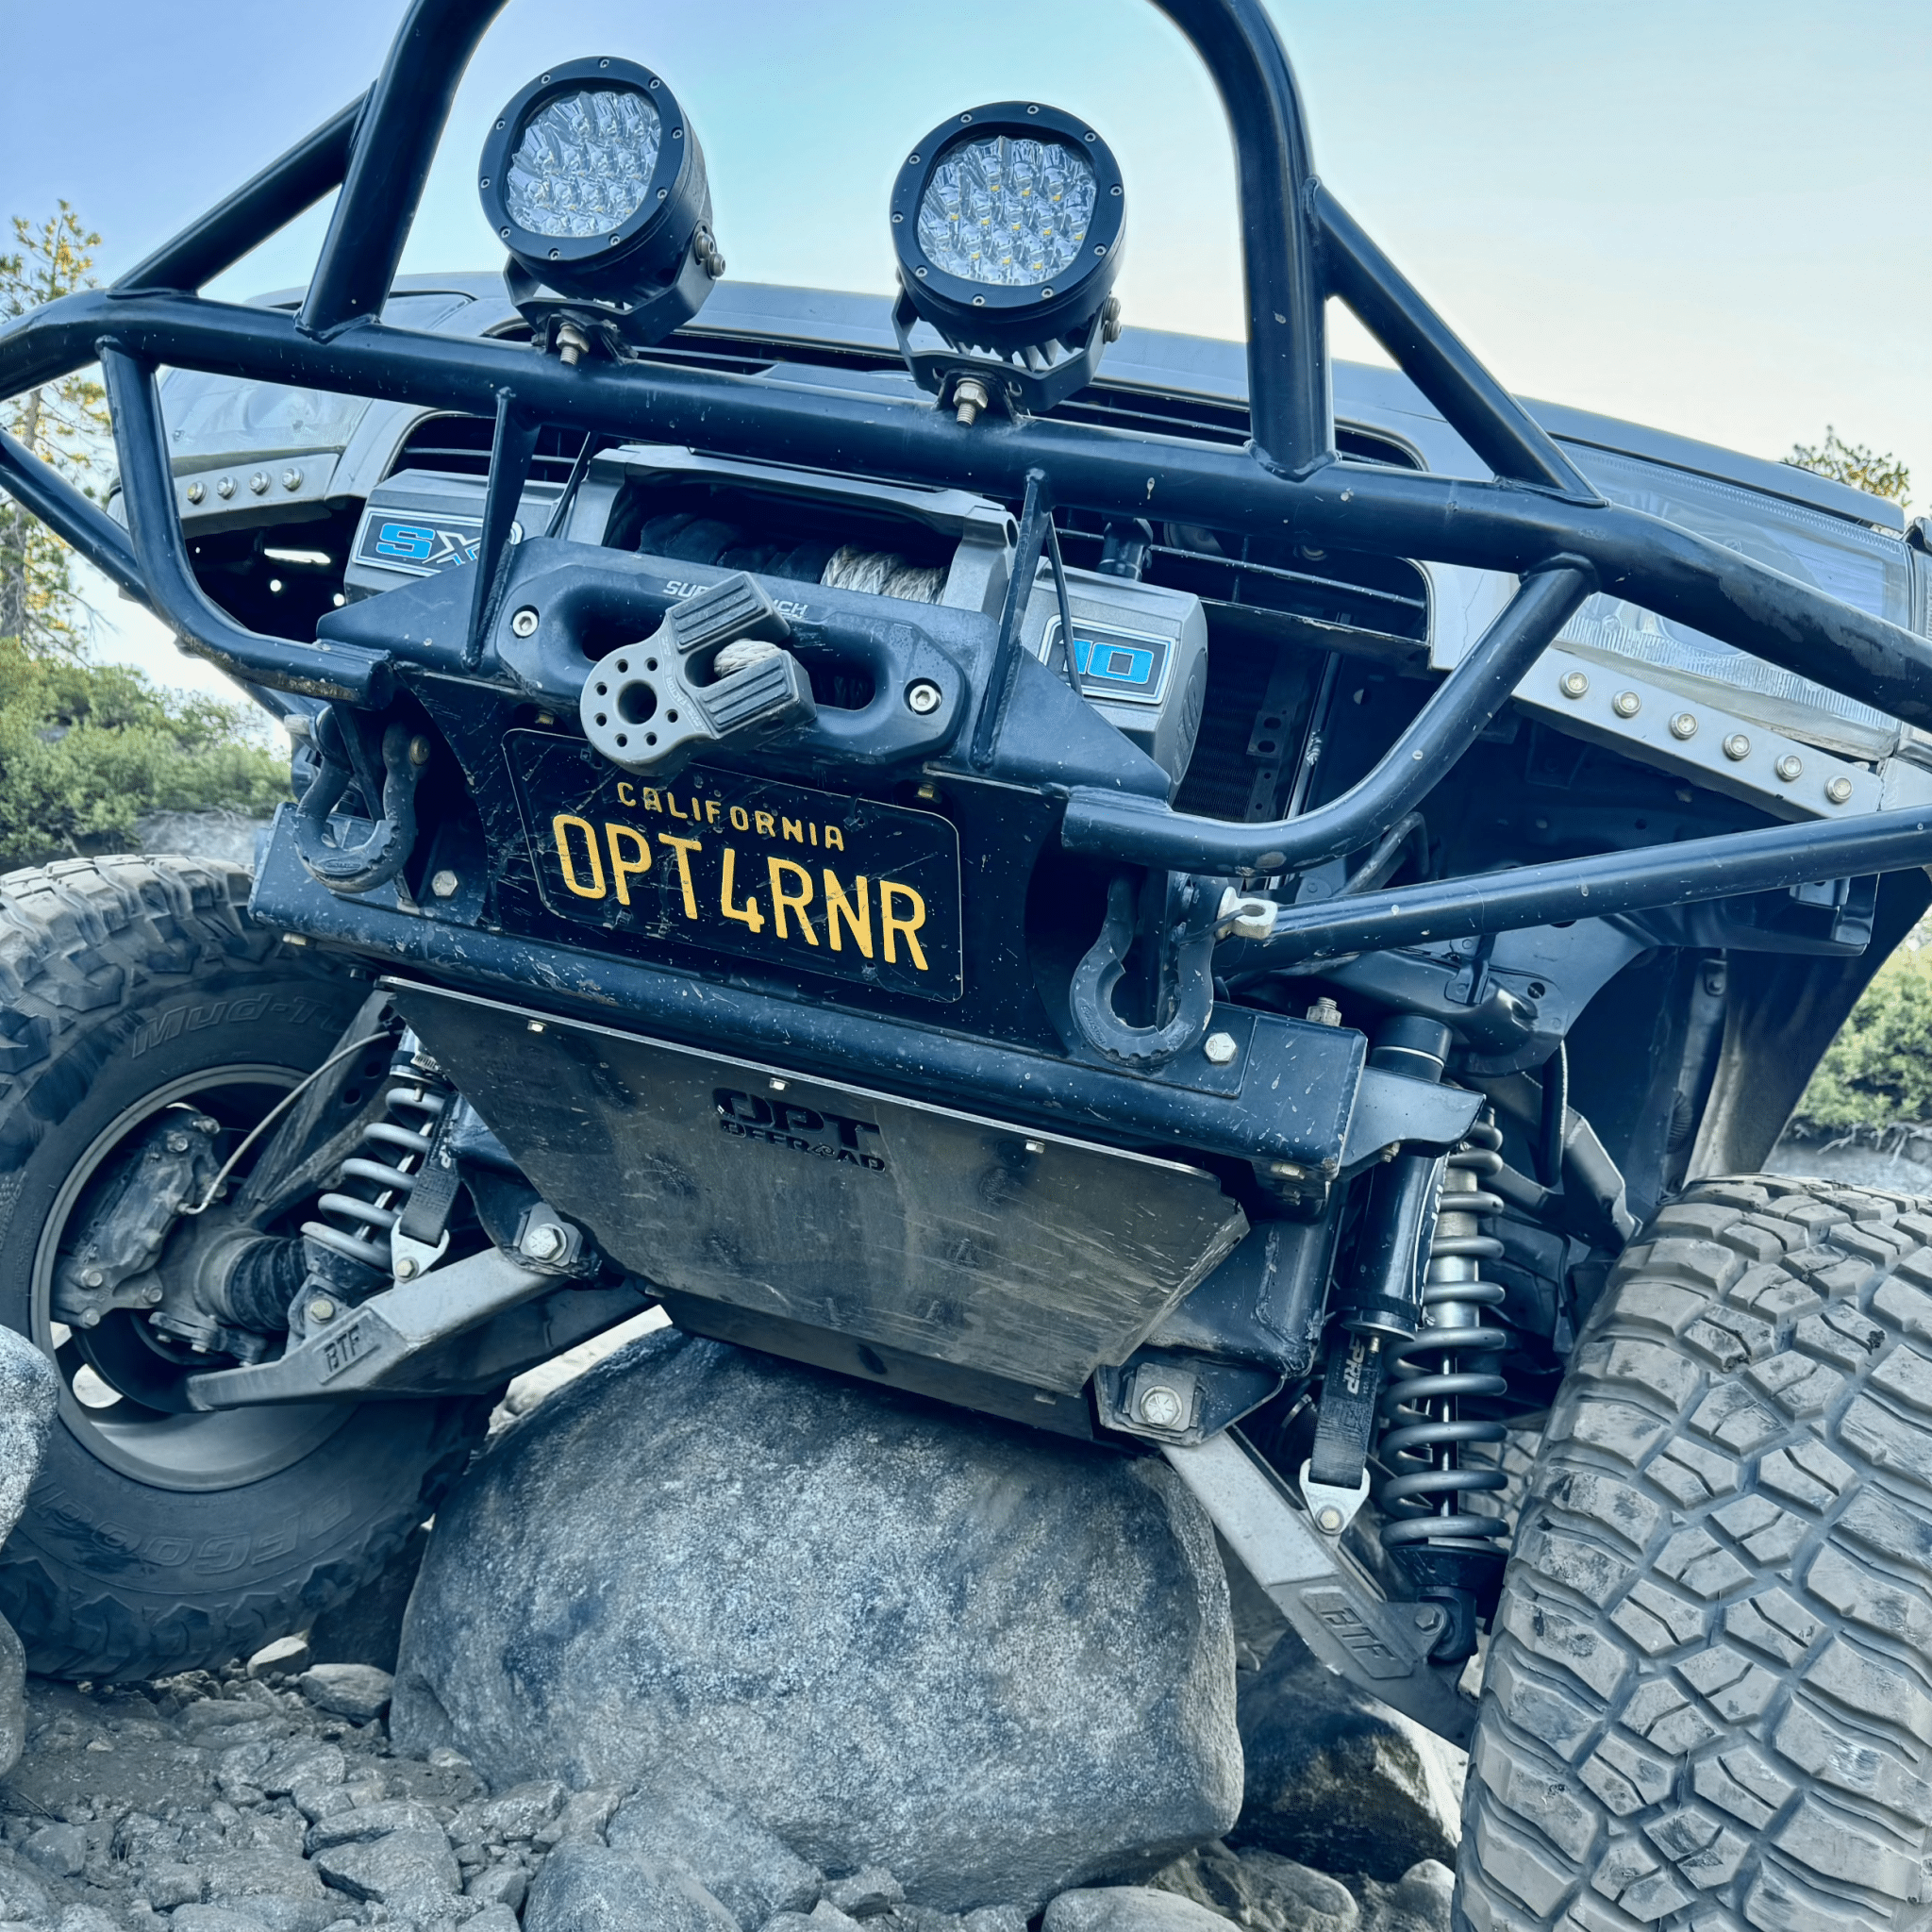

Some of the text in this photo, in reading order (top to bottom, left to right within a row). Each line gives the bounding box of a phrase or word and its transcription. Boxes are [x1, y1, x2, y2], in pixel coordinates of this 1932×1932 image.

[617, 782, 844, 852] CALIFORNIA
[552, 813, 929, 972] OPT4RNR
[712, 1088, 881, 1151] OPT
